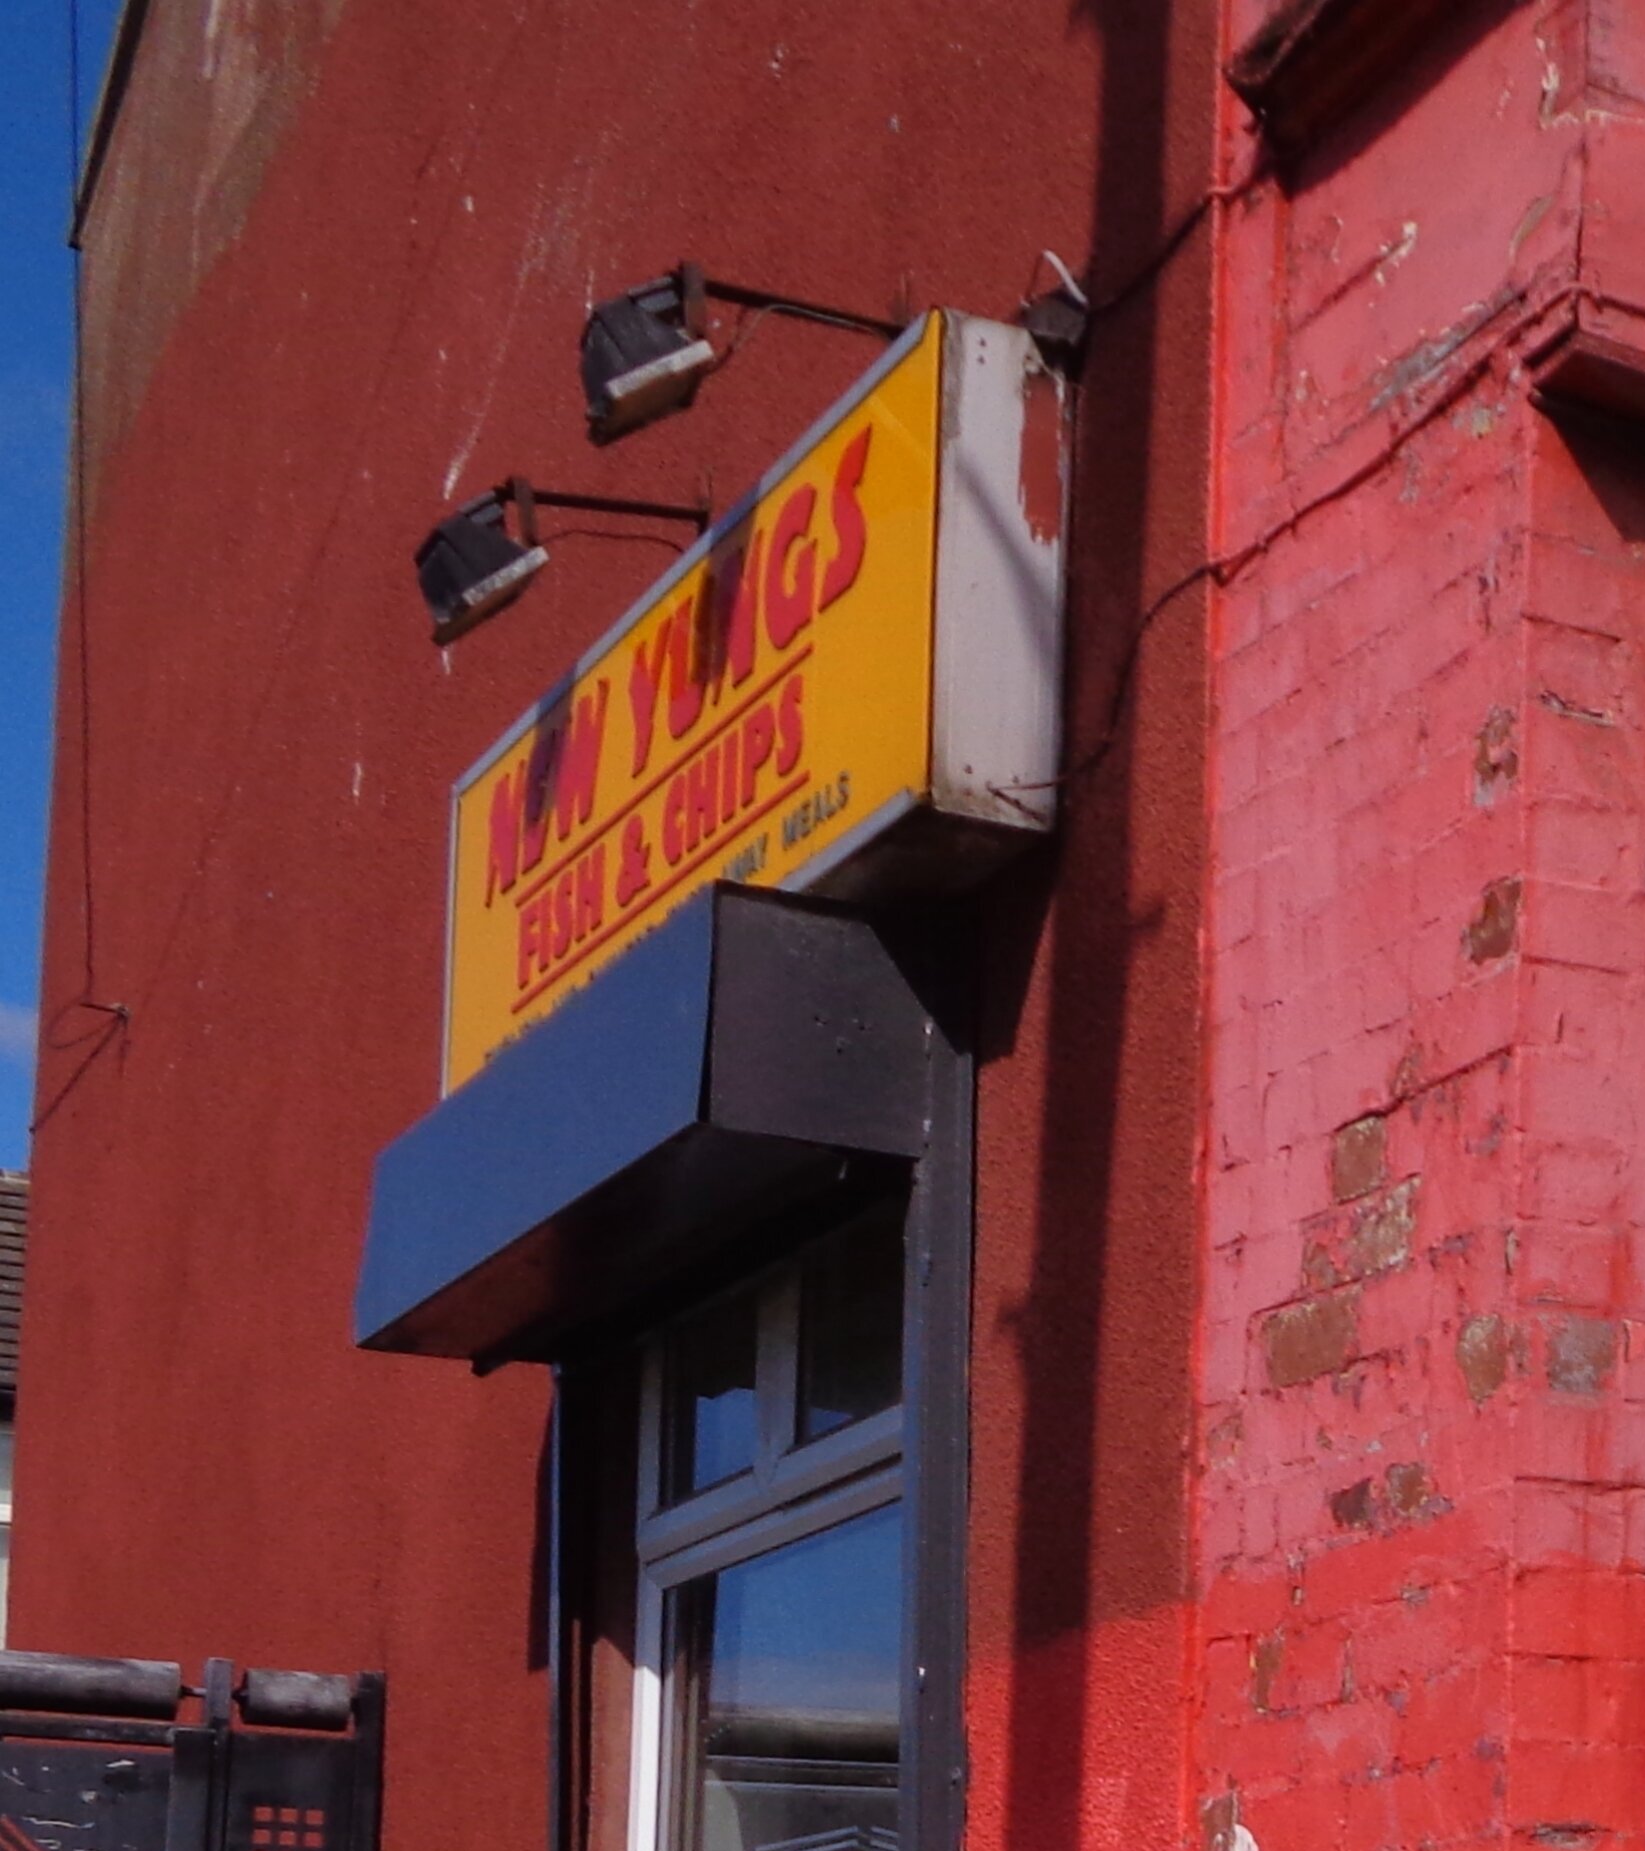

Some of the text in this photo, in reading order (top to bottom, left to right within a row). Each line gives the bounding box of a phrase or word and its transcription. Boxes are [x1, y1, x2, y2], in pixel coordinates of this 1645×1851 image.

[485, 423, 872, 908] NEW YUNGS
[782, 770, 850, 851] MEALS
[518, 842, 606, 990] FISH
[617, 814, 651, 907] &
[662, 674, 805, 866] CHIPS
